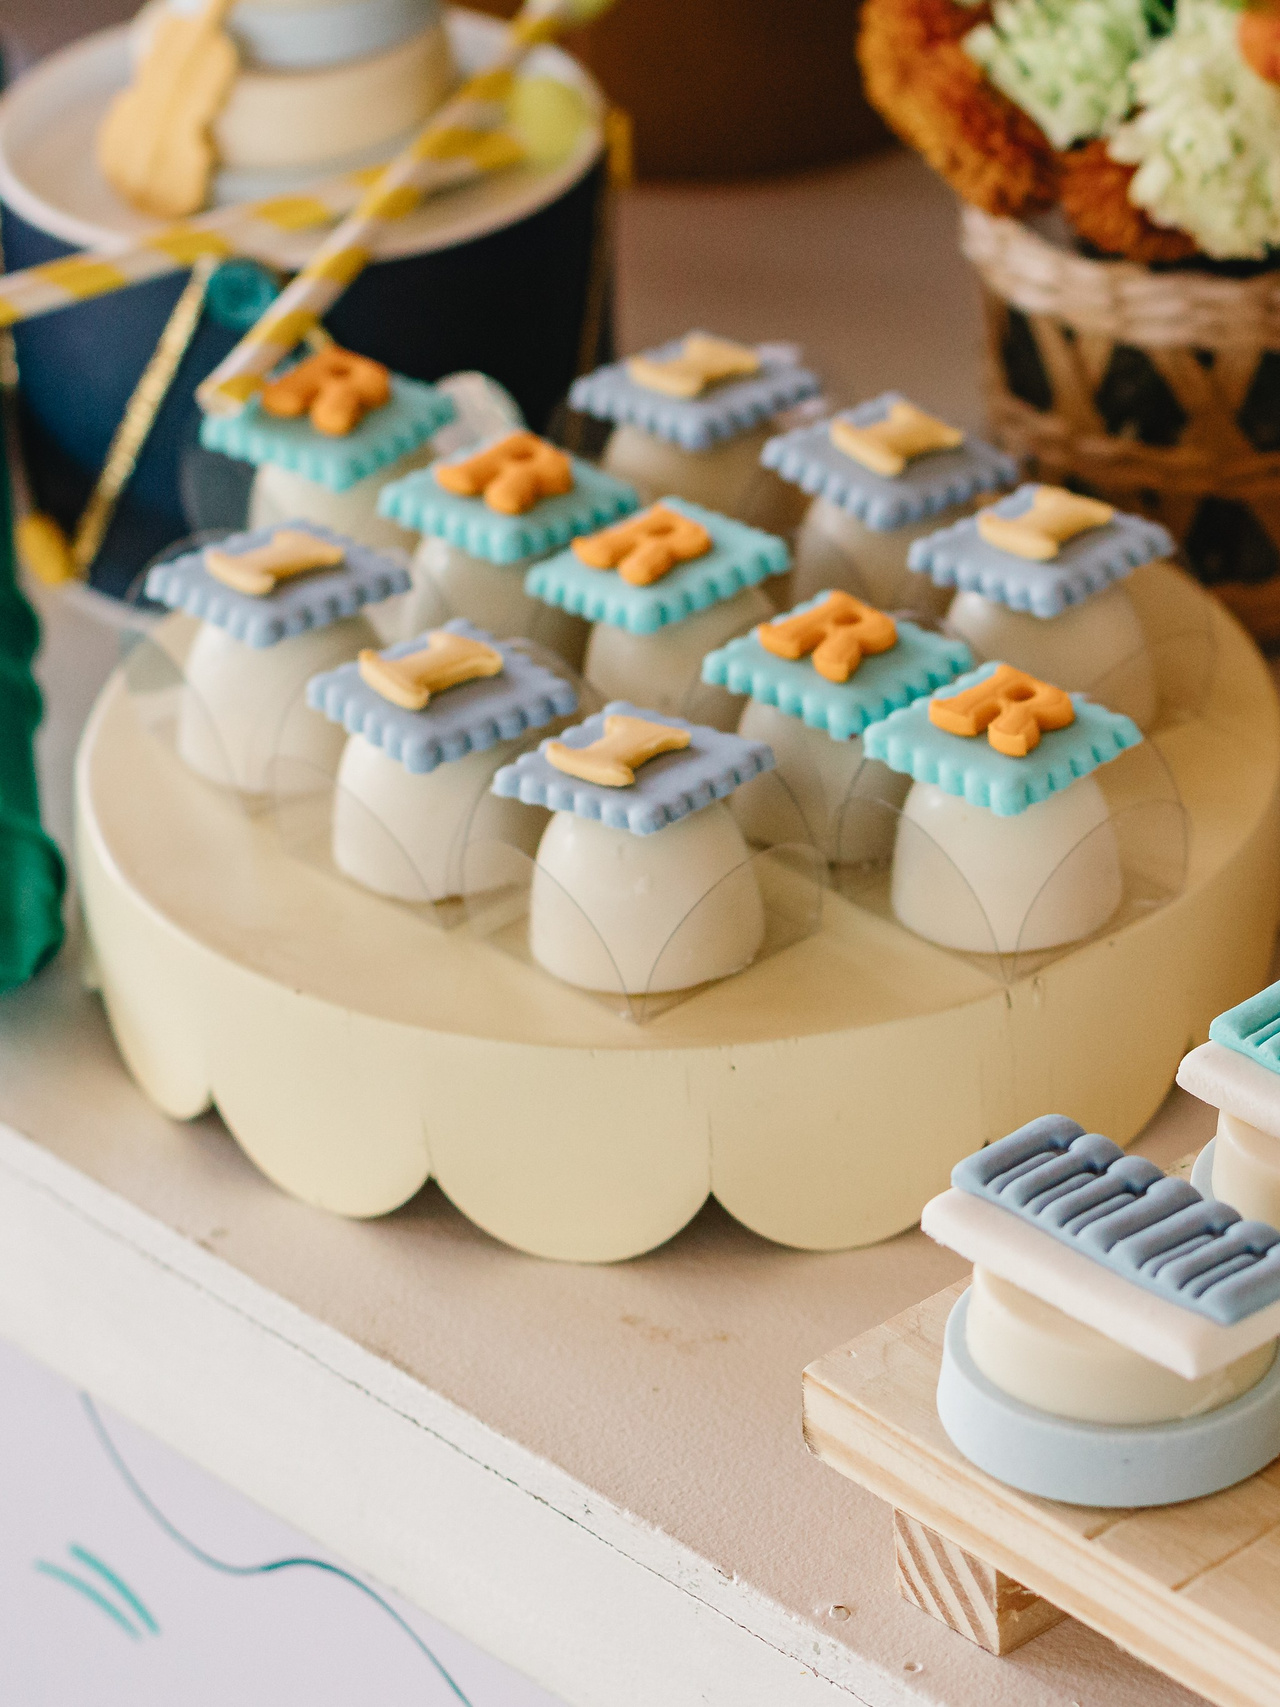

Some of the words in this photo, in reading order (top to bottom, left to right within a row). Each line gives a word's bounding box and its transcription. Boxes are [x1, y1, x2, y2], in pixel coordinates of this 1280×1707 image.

[262, 344, 391, 436] R
[435, 430, 574, 517] R
[570, 502, 713, 588] R
[758, 590, 898, 683] R
[928, 663, 1076, 757] R
